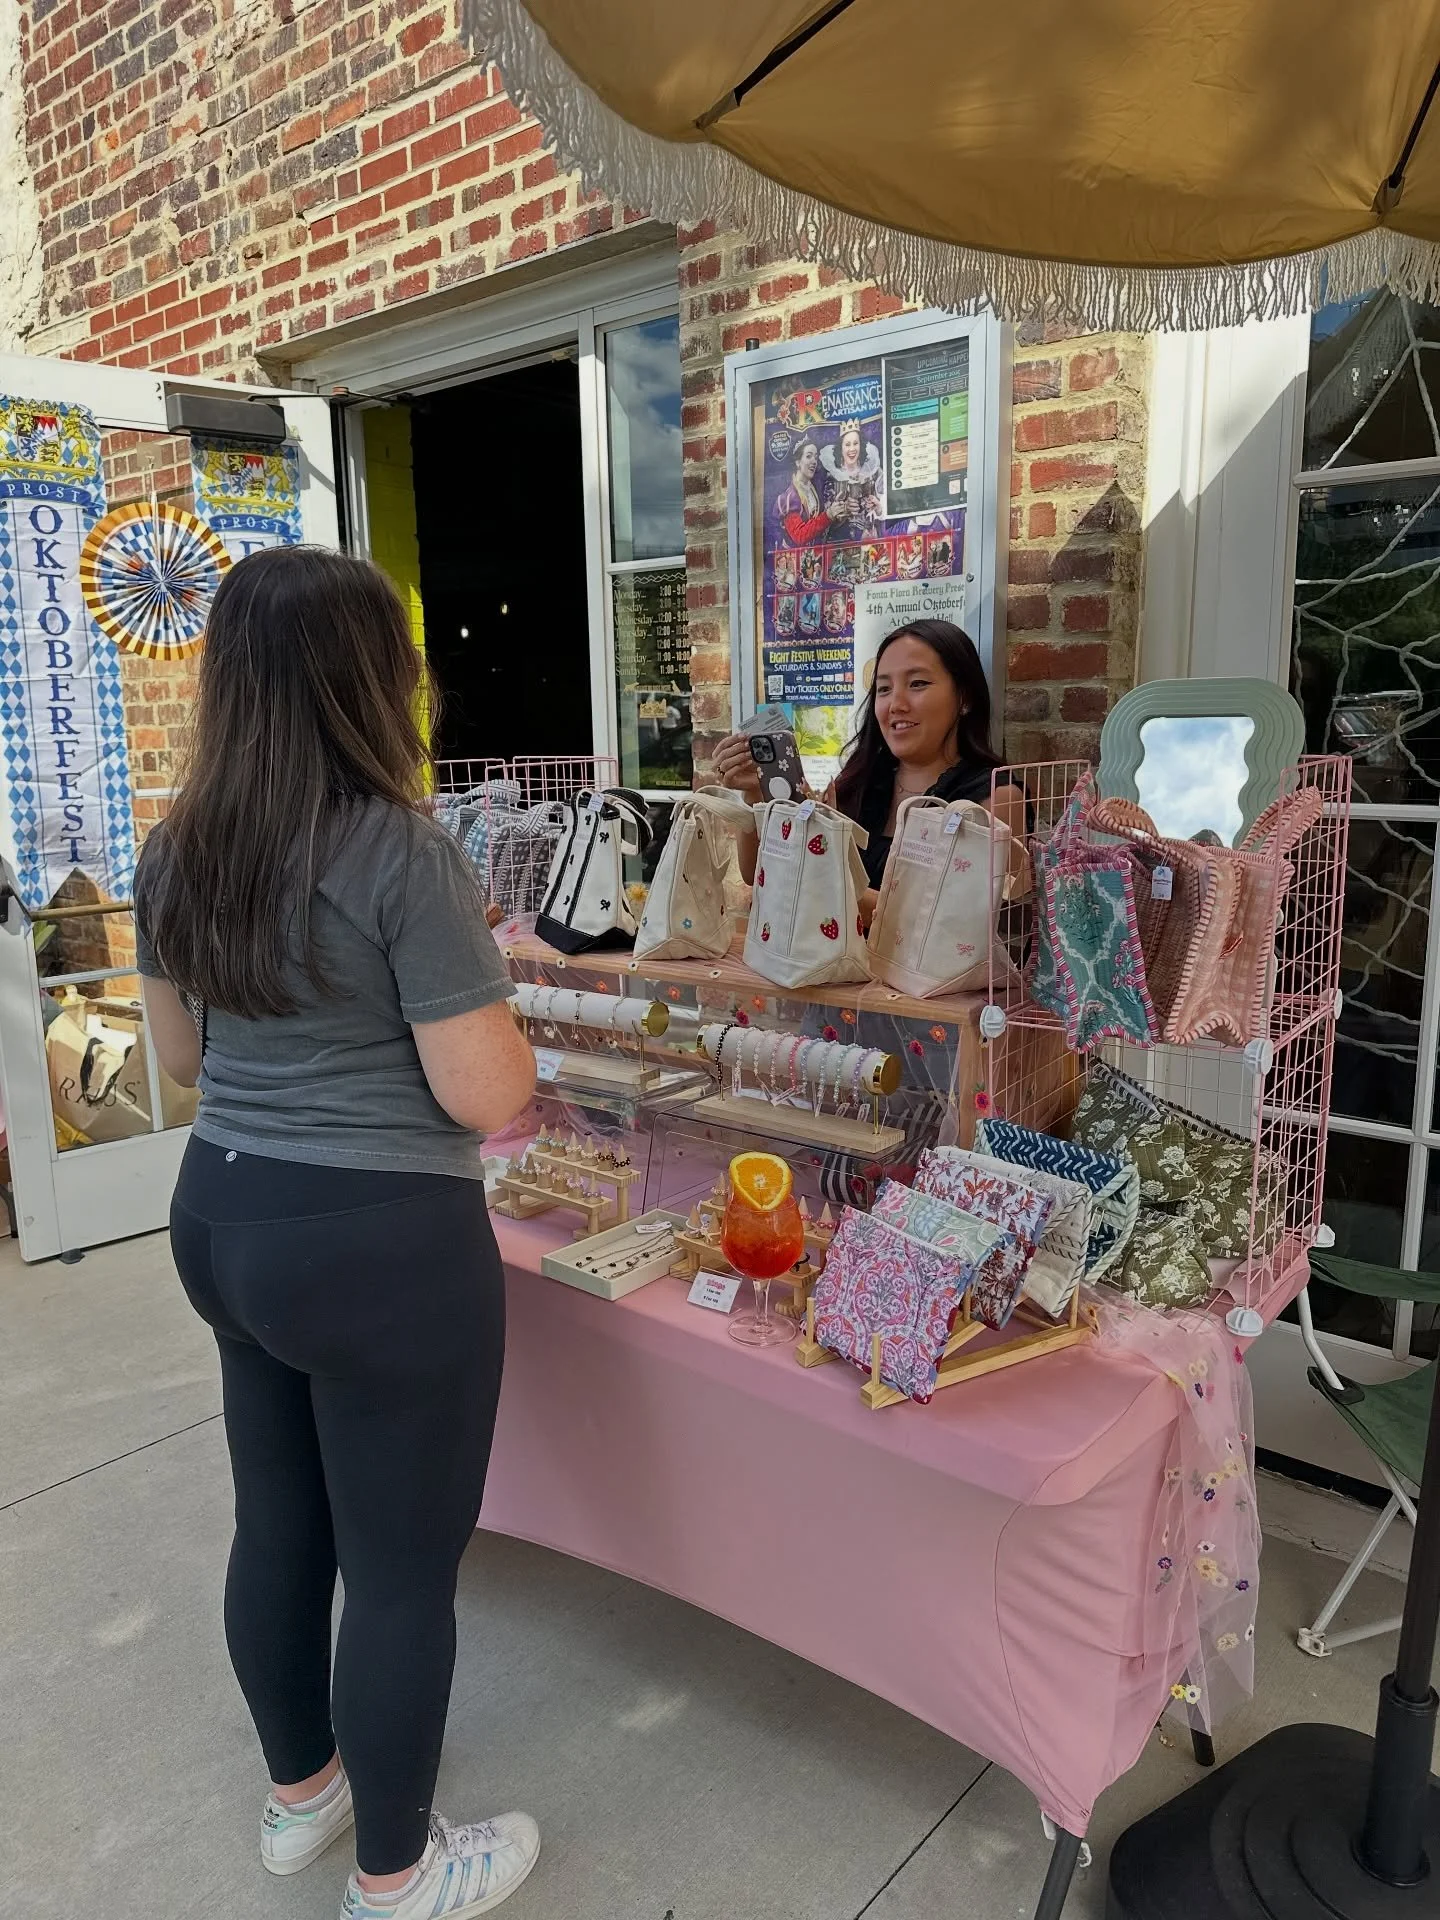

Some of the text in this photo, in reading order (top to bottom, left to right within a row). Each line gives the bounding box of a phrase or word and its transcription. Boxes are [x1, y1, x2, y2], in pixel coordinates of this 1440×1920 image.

[917, 356, 948, 369] UPCOMING
[855, 380, 879, 389] CAROLINA
[917, 372, 947, 385] September
[824, 411, 831, 419] &
[831, 403, 867, 418] ARTISAN
[7, 482, 81, 502] PROST
[220, 516, 281, 533] PROST
[866, 590, 888, 600] Fonta
[890, 587, 910, 599] Flora
[866, 603, 883, 616] 4th
[885, 600, 921, 614] Annual
[769, 648, 851, 664] EIGHT FESTIVE WEEKENDS
[774, 663, 809, 672] SATURDAYS
[810, 662, 815, 670] &
[816, 662, 842, 670] SUNDAYS
[28, 504, 85, 863] OKTOBERFEST
[784, 685, 796, 693] BUY
[797, 685, 819, 693] TICKETS
[819, 684, 835, 693] ONLY
